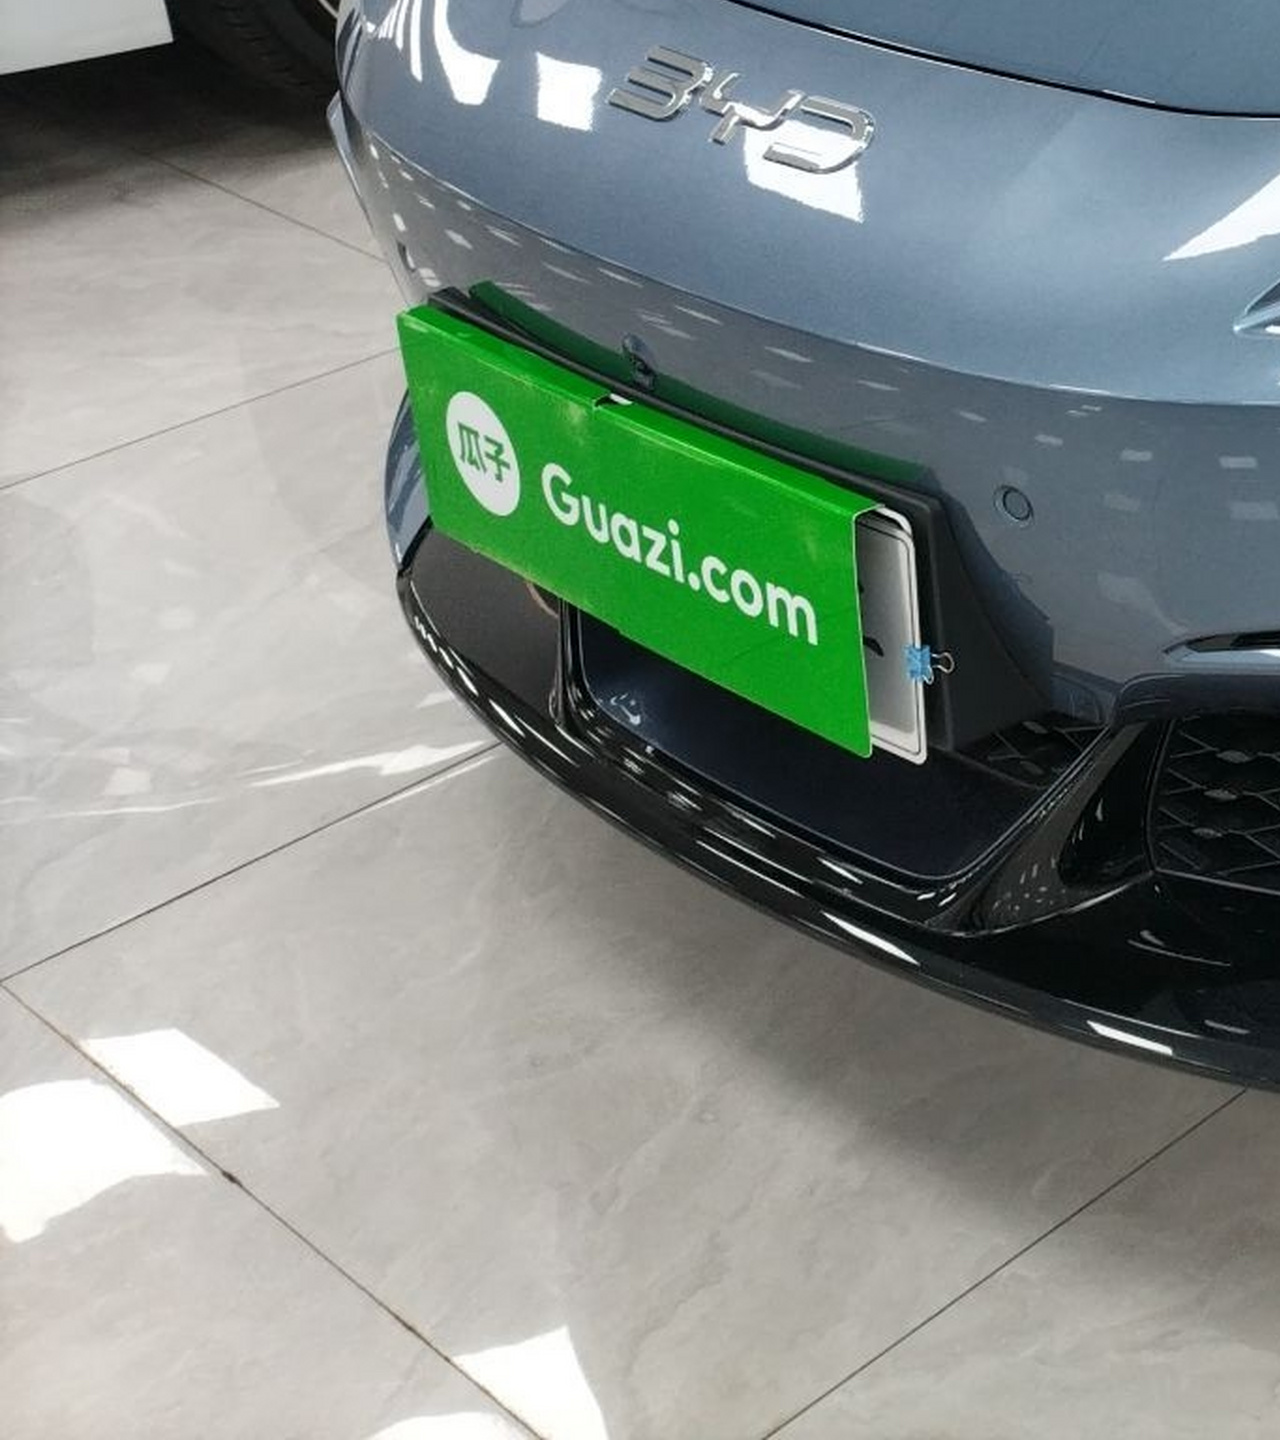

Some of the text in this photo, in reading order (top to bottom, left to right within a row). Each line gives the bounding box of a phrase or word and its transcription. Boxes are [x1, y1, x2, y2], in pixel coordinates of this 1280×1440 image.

[606, 44, 874, 175] BYD
[457, 422, 511, 483] 瓜子
[541, 463, 818, 646] Guazi.com
